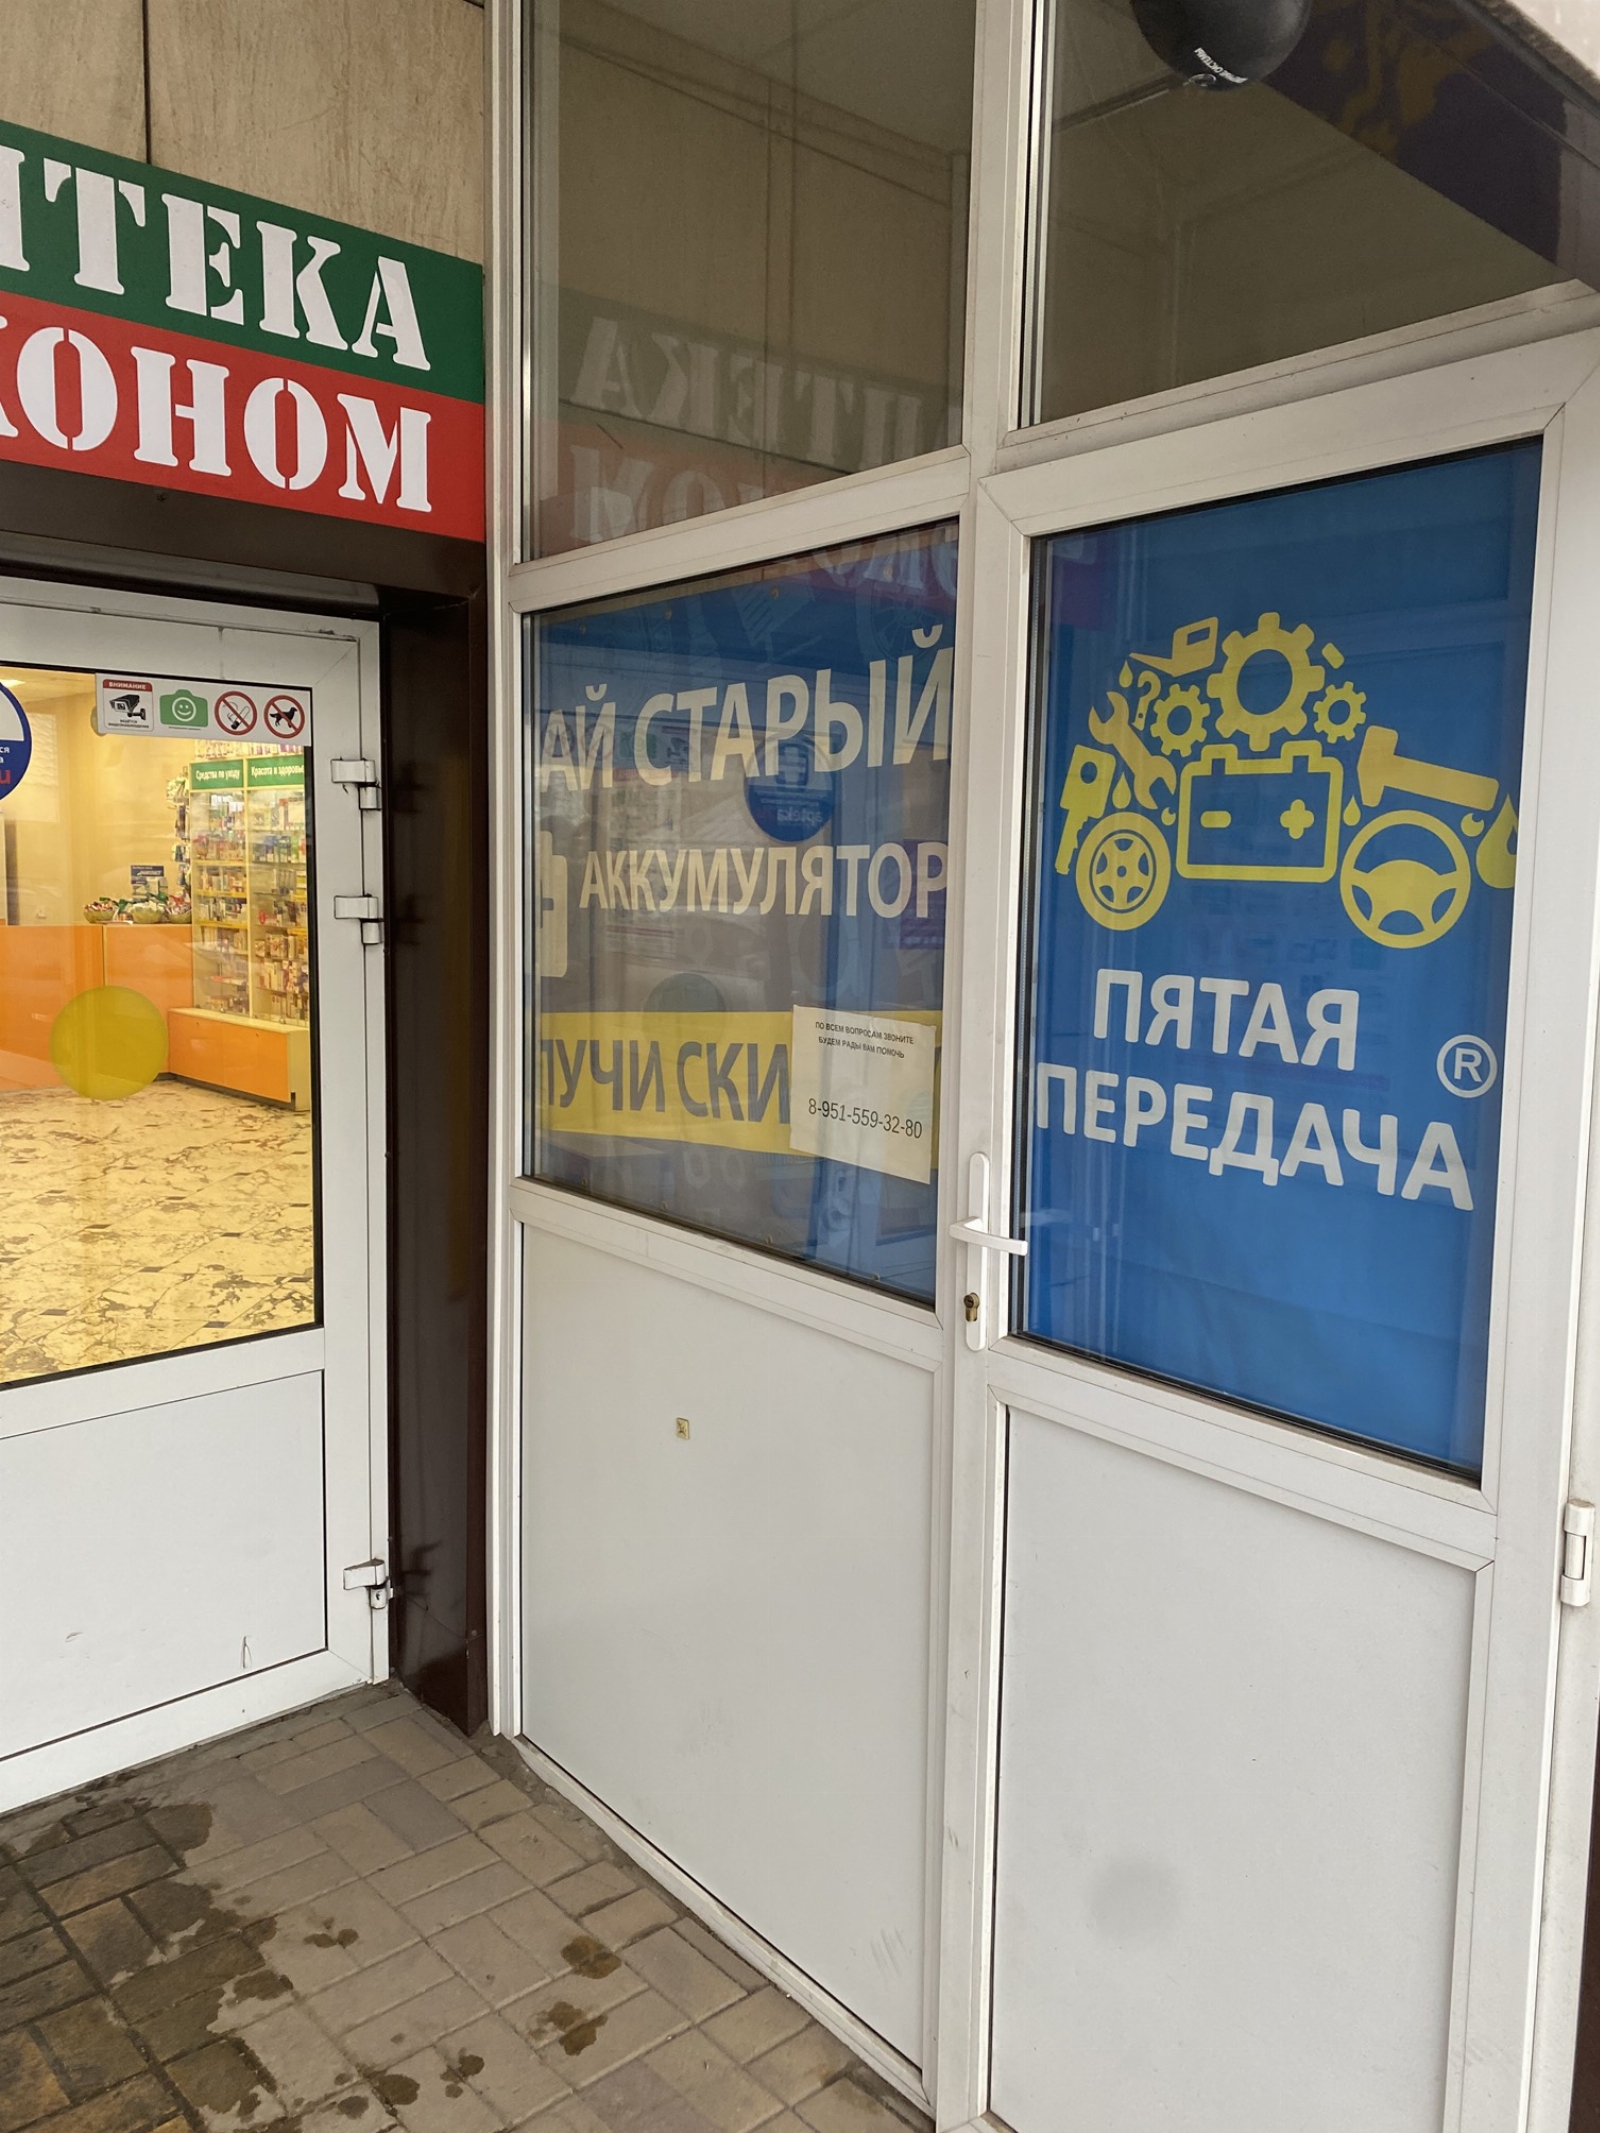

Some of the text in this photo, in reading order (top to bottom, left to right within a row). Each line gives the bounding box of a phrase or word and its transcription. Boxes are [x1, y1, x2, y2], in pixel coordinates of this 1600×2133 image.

[0, 315, 432, 513] ОНОМ
[108, 682, 147, 690] ВНИМАНИЕ
[633, 624, 955, 787] СТАРЫЙ
[251, 766, 273, 778] Красота
[579, 841, 948, 919] АККУМУЛЯТОР
[815, 1021, 915, 1045] ПО ВСЕМ ВОПРОСАМ ЗВОНИТЕ
[818, 1036, 905, 1059] БУДЕМ РАДЫ ВАМ ПОМОЧЬ
[1093, 968, 1360, 1071] ПЯТАЯ
[808, 1097, 923, 1139] 8-951-559-32-80
[1037, 1062, 1474, 1211] ПЕРЕДАЧА
